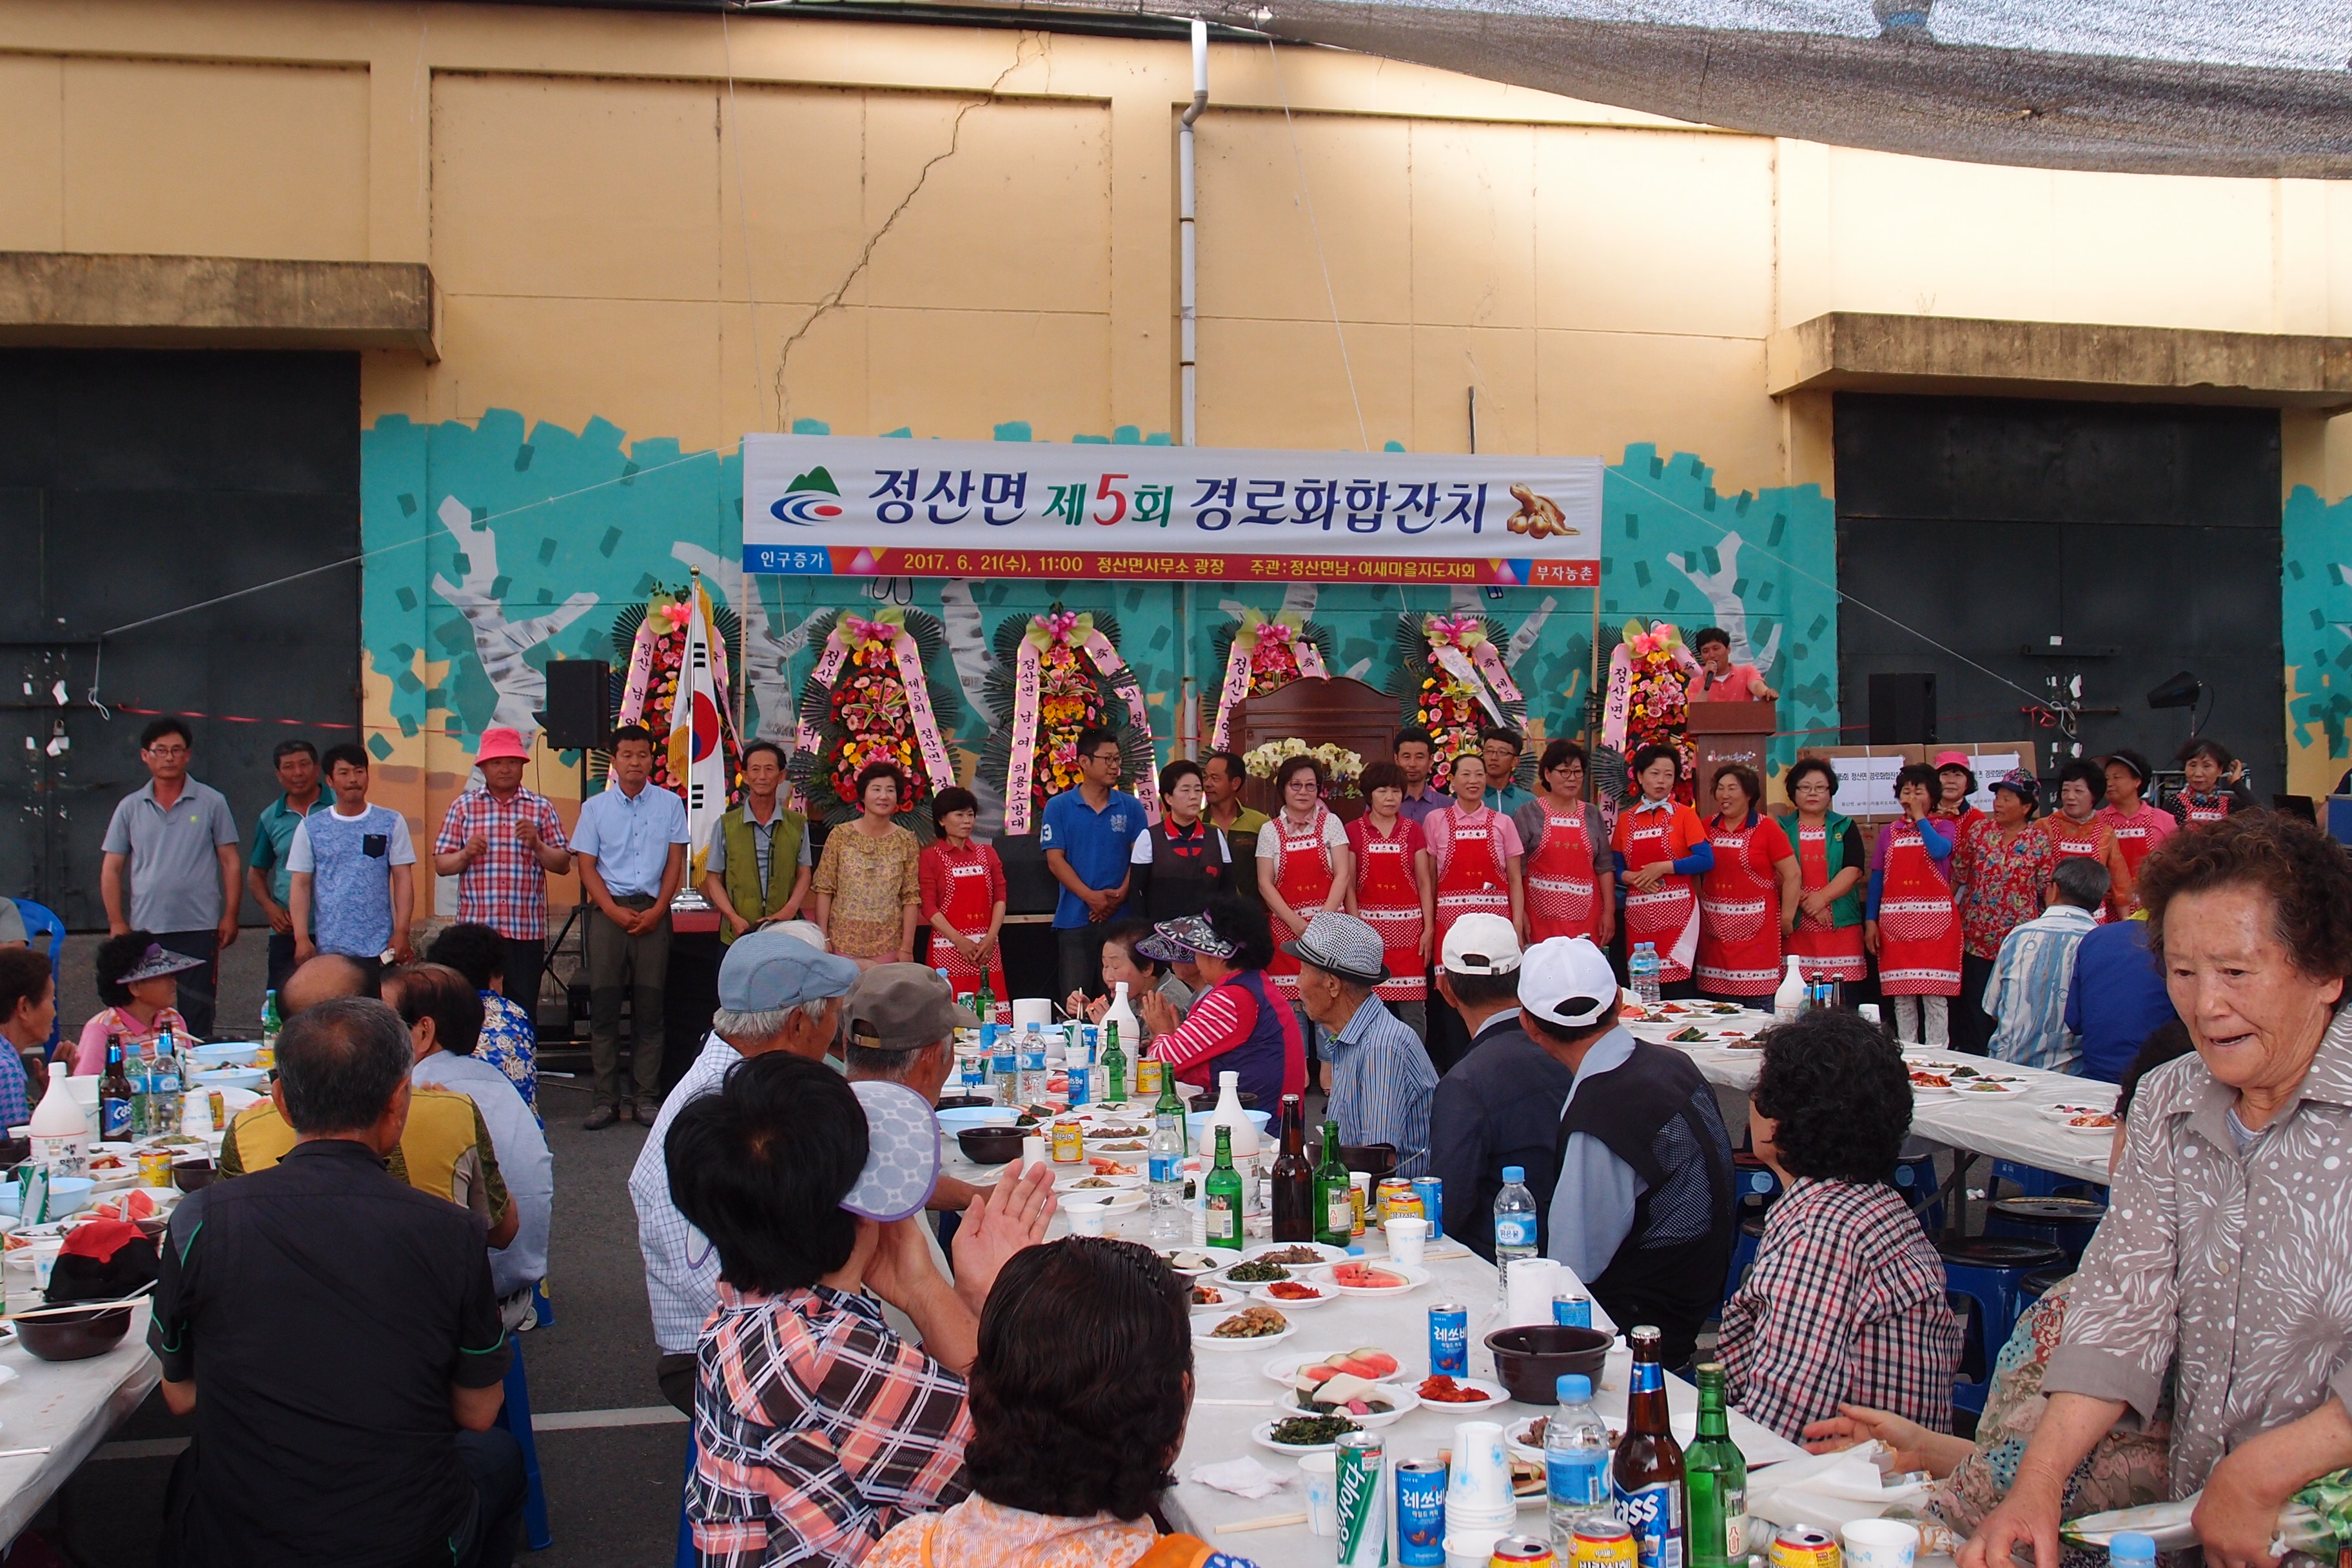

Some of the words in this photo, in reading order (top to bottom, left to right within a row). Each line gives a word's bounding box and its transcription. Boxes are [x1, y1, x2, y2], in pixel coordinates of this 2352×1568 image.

[868, 467, 1028, 526] 정산면
[1041, 473, 1173, 527] 제5회
[1190, 476, 1488, 534] 경로화합잔치
[760, 551, 824, 569] 인구증가
[904, 553, 949, 570] 2017.
[957, 554, 973, 571] 6.
[980, 554, 1032, 573] 21(수),
[1039, 556, 1083, 572] 11:00
[1097, 556, 1190, 574] 정산면사무소
[1194, 558, 1225, 574] 광장
[1536, 565, 1594, 581] 부자농촌
[901, 653, 916, 665] 축
[1483, 658, 1497, 669] 축
[1021, 658, 1037, 698] 정산면
[907, 678, 926, 715] 제5회
[1611, 667, 1627, 720] 정산면
[919, 728, 943, 764] 정산면
[1010, 763, 1028, 830] 의용소방대
[1433, 1326, 1467, 1342] 레쓰비
[1402, 1487, 1446, 1510] 레쓰비
